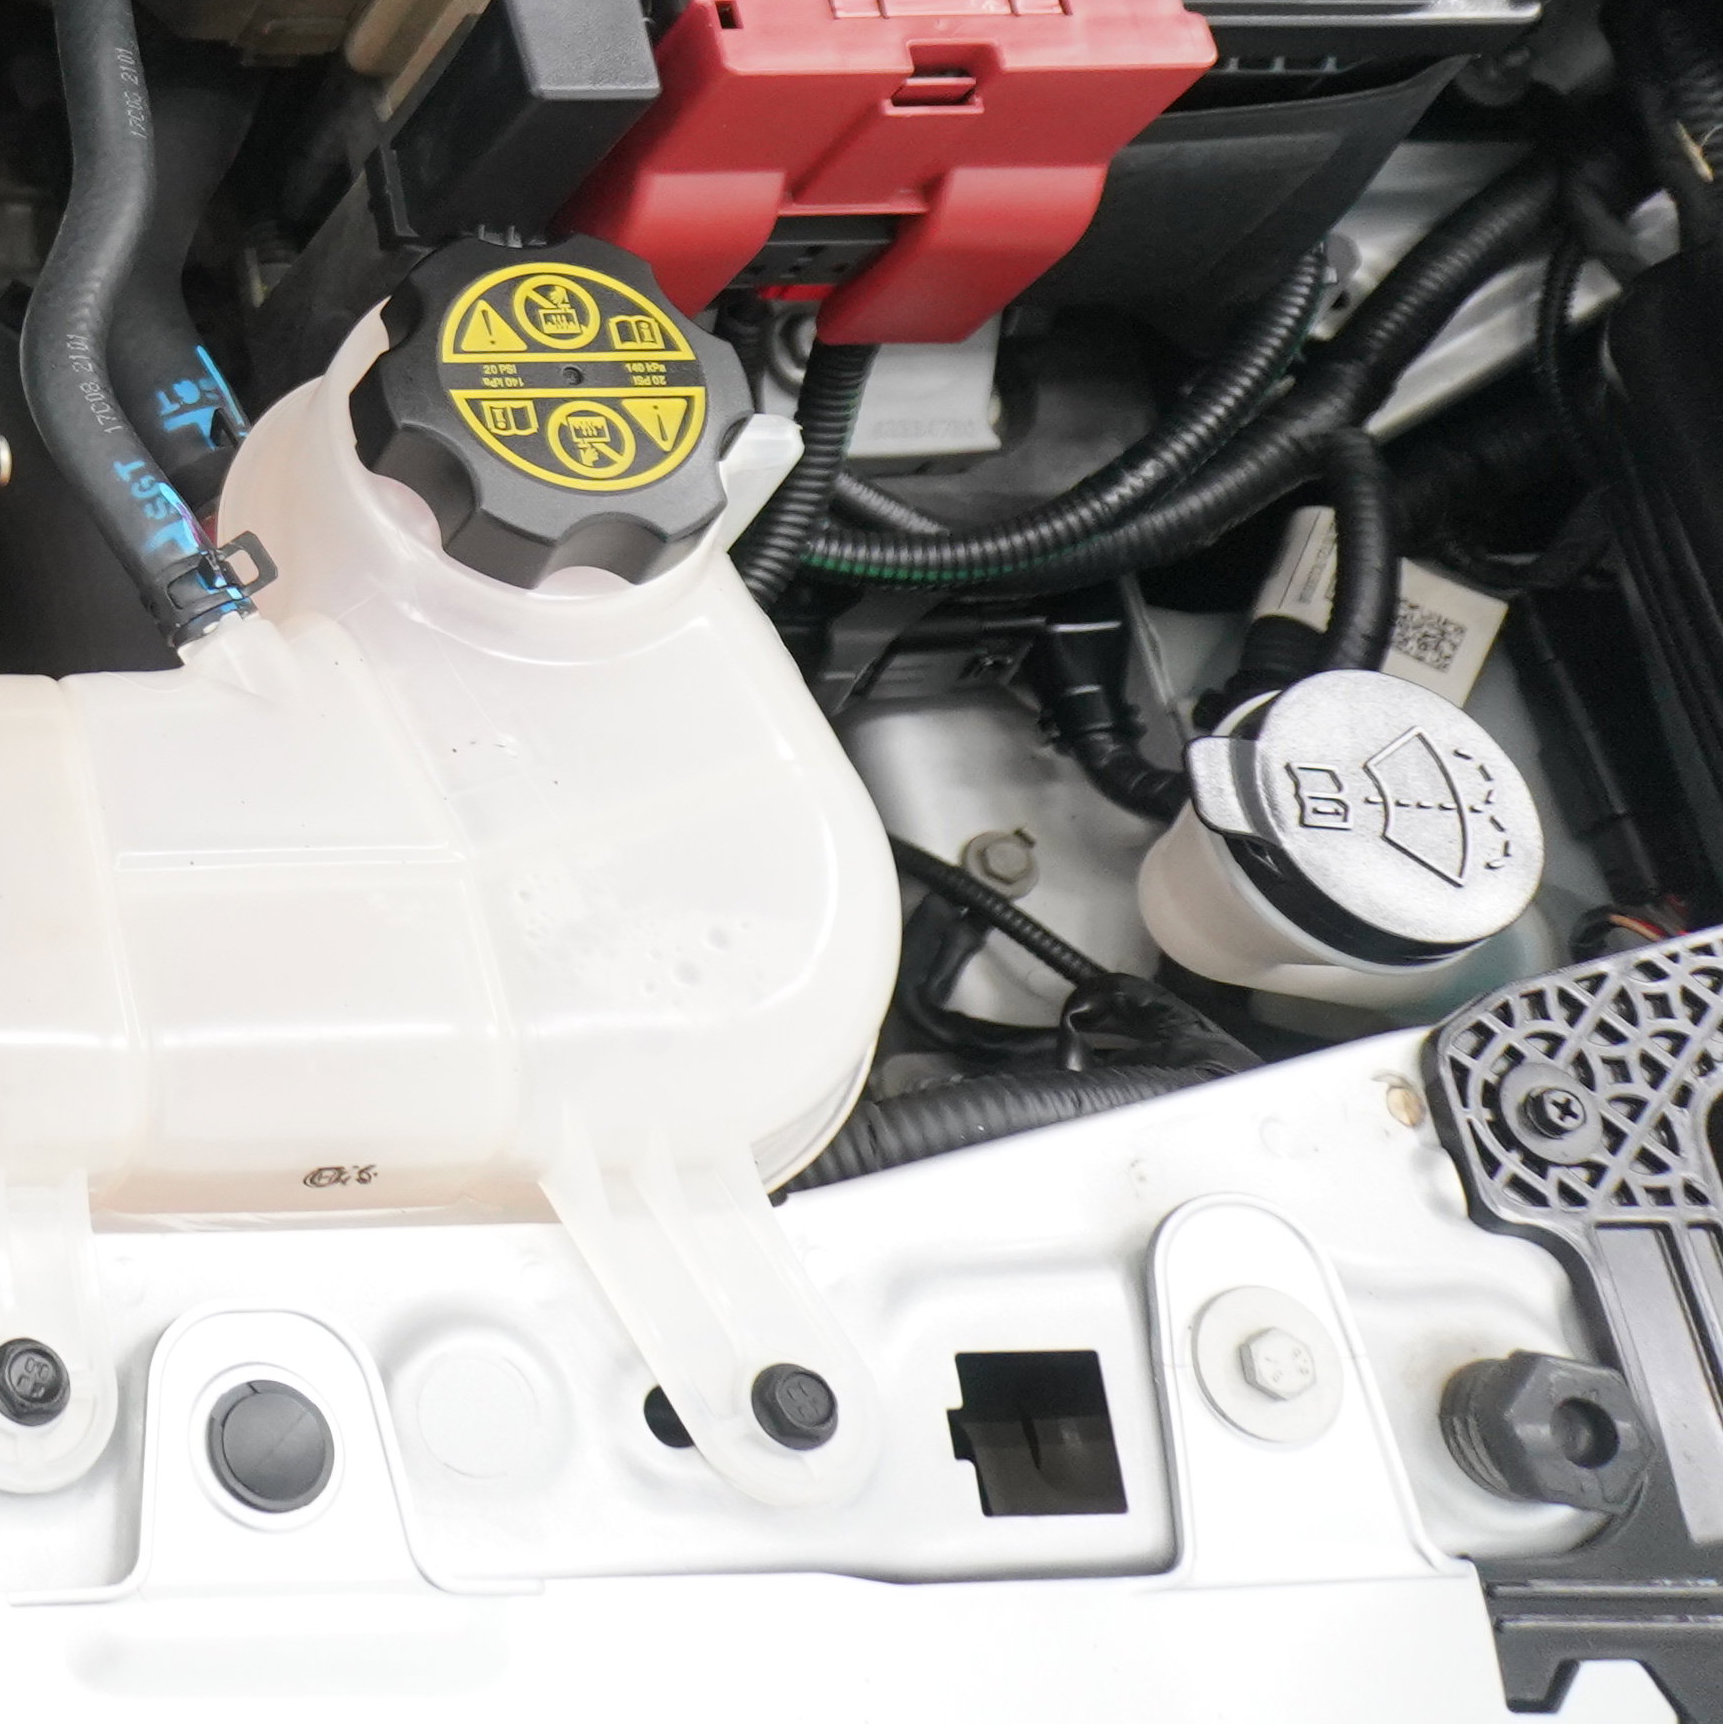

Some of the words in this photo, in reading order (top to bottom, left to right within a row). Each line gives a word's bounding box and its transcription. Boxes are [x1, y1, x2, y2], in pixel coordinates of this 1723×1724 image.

[482, 364, 498, 375] 20
[500, 364, 517, 374] PSI
[625, 363, 644, 373] 140
[505, 377, 525, 388] 140
[632, 375, 648, 386] PSI
[650, 375, 667, 386] 20
